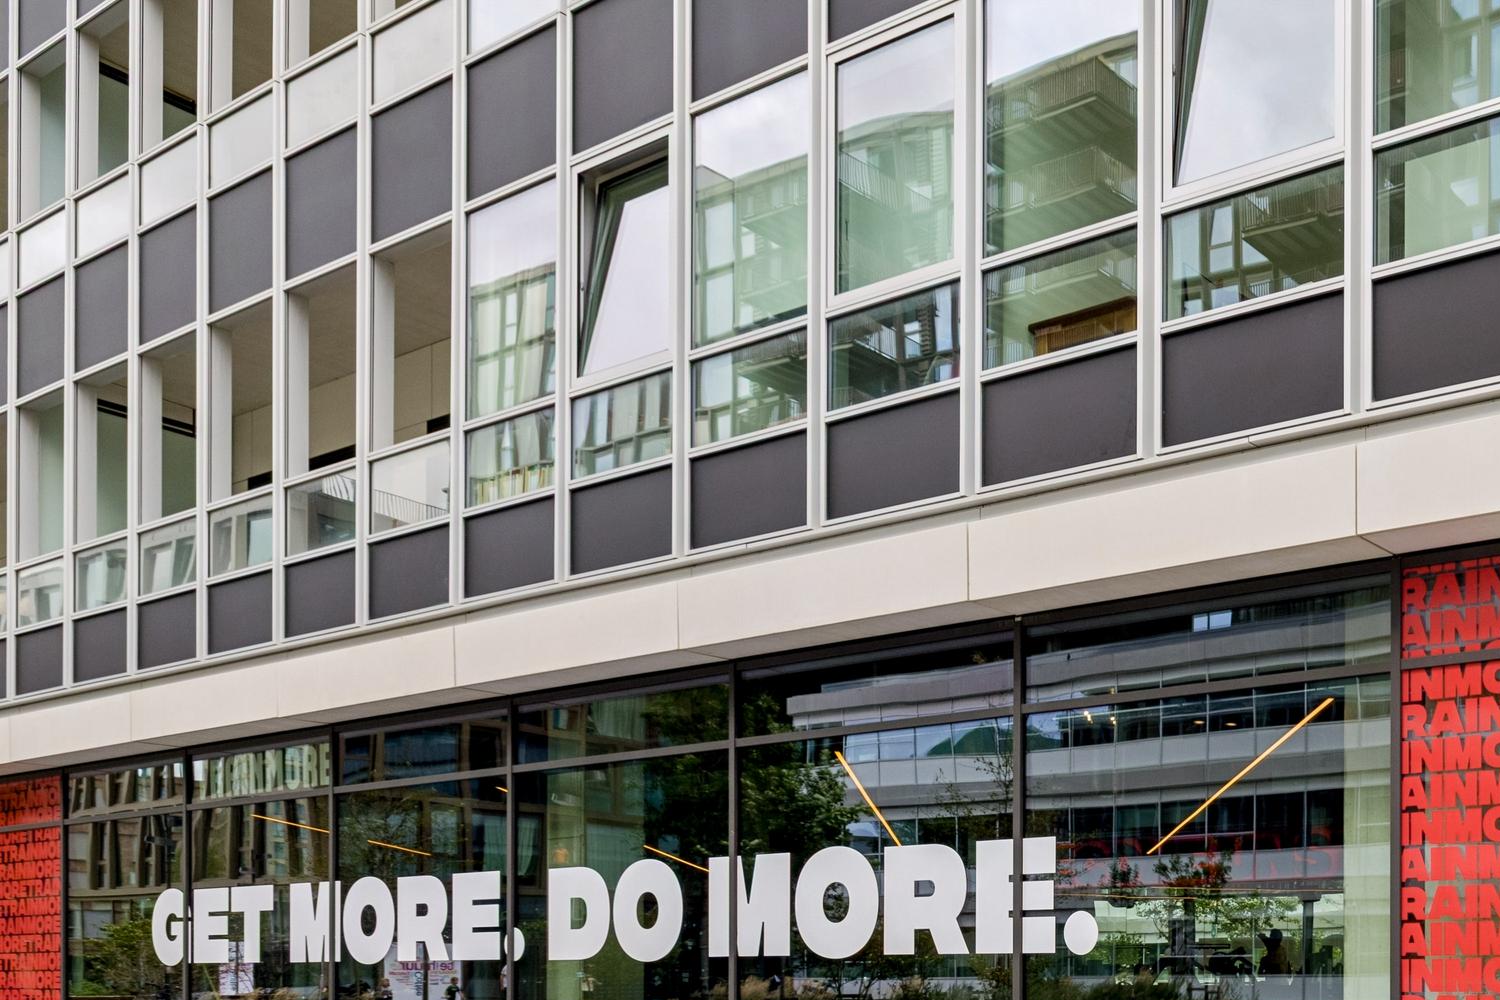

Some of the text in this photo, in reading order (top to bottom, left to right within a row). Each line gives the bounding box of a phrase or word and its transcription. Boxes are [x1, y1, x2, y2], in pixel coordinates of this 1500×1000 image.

[152, 836, 1098, 966] GET MORE. DO MORE.
